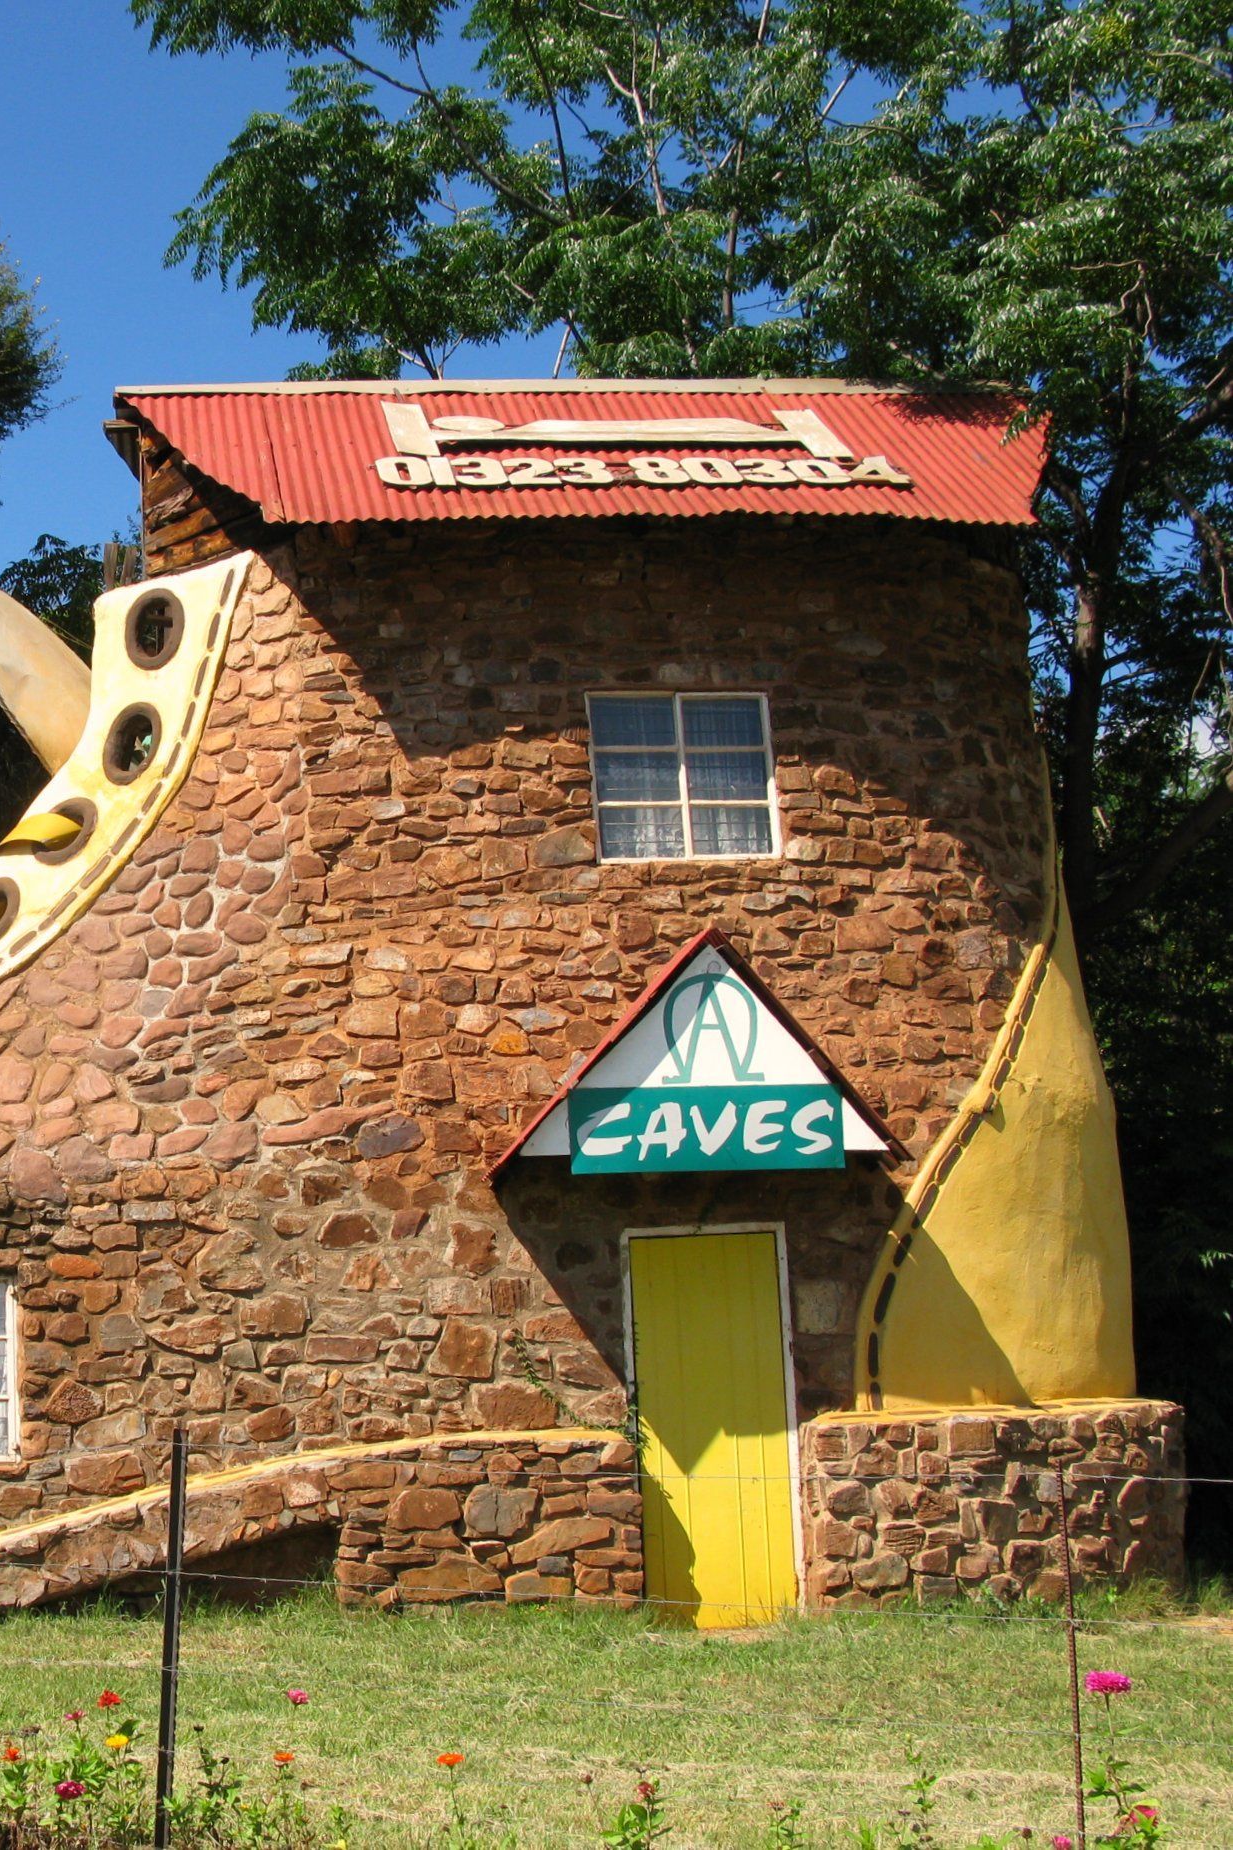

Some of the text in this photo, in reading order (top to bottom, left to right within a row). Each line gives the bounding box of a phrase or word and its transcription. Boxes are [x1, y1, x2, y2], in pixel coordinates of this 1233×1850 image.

[375, 456, 912, 486] 01323 80304
[577, 1100, 834, 1161] CAVES
